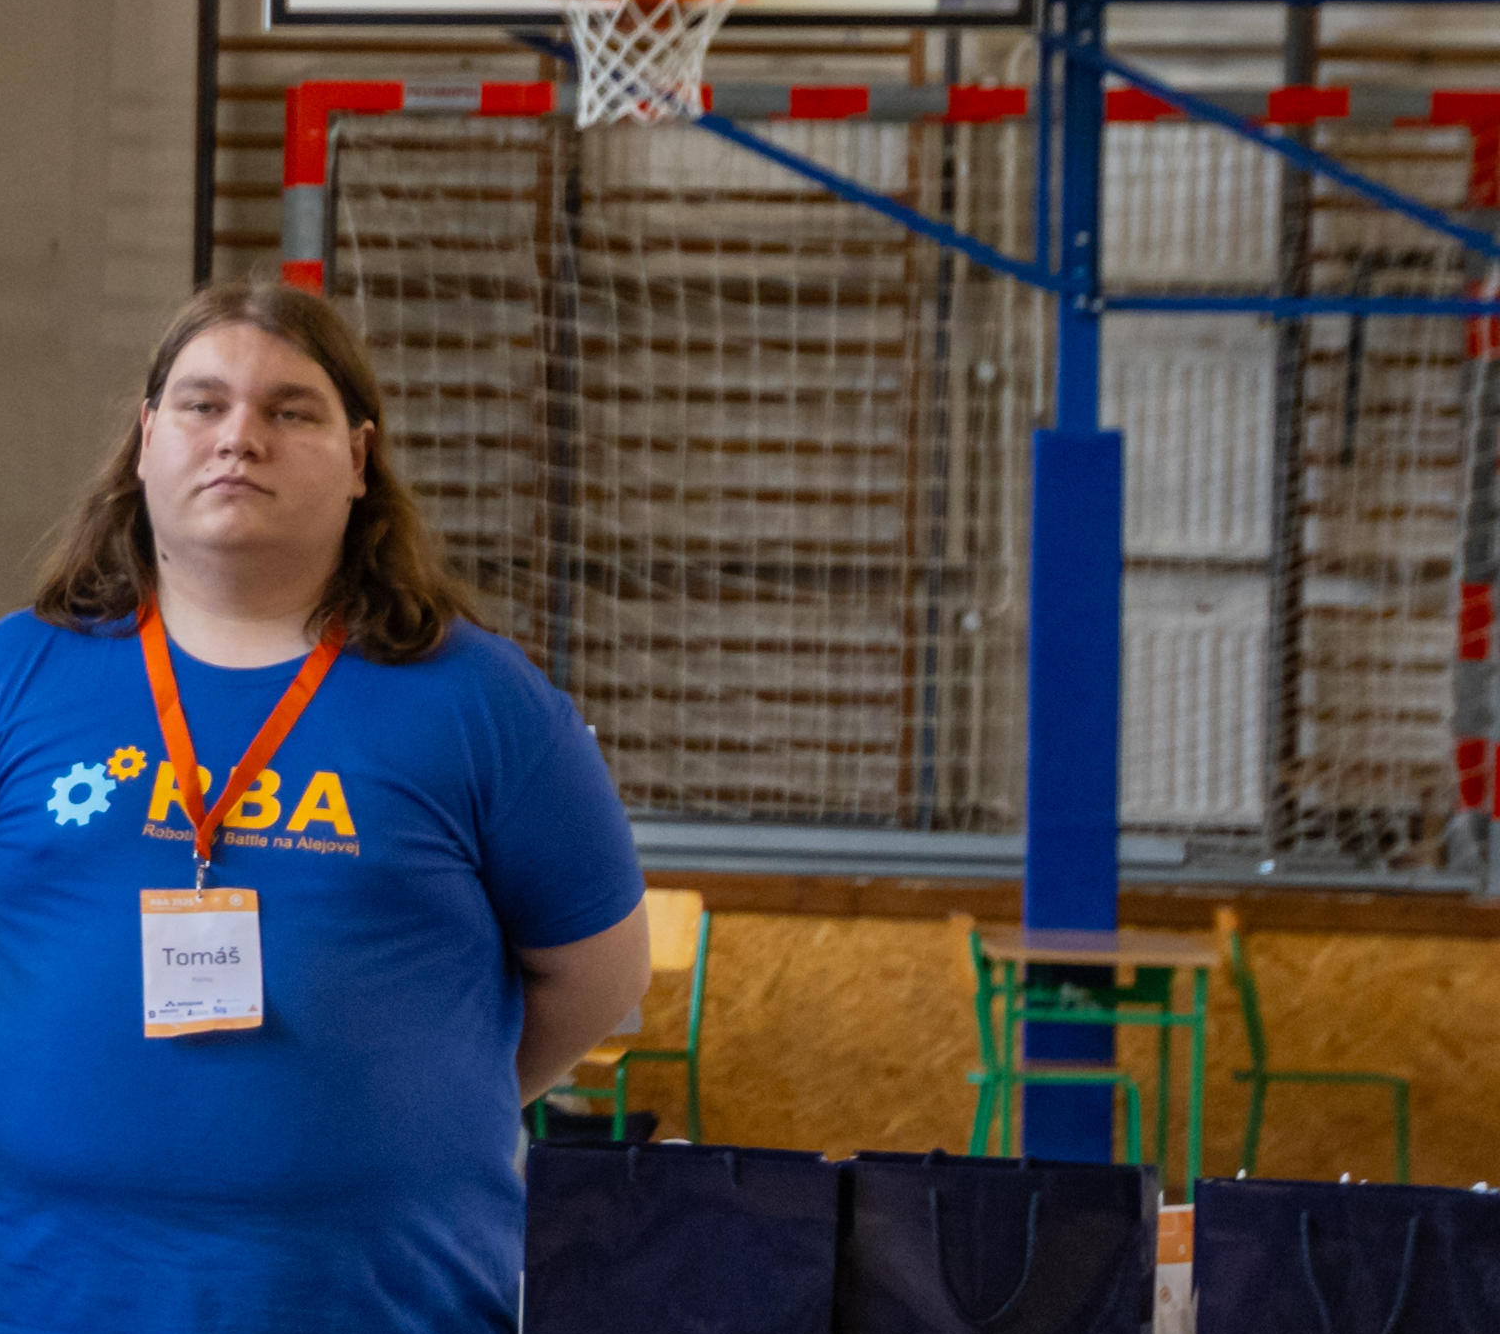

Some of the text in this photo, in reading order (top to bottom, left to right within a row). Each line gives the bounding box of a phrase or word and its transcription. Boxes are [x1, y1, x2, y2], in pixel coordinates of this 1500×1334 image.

[148, 760, 357, 837] RBA
[224, 831, 269, 848] Battle
[273, 837, 293, 849] na
[297, 836, 360, 858] Alejovej
[162, 946, 241, 966] Tomáš
